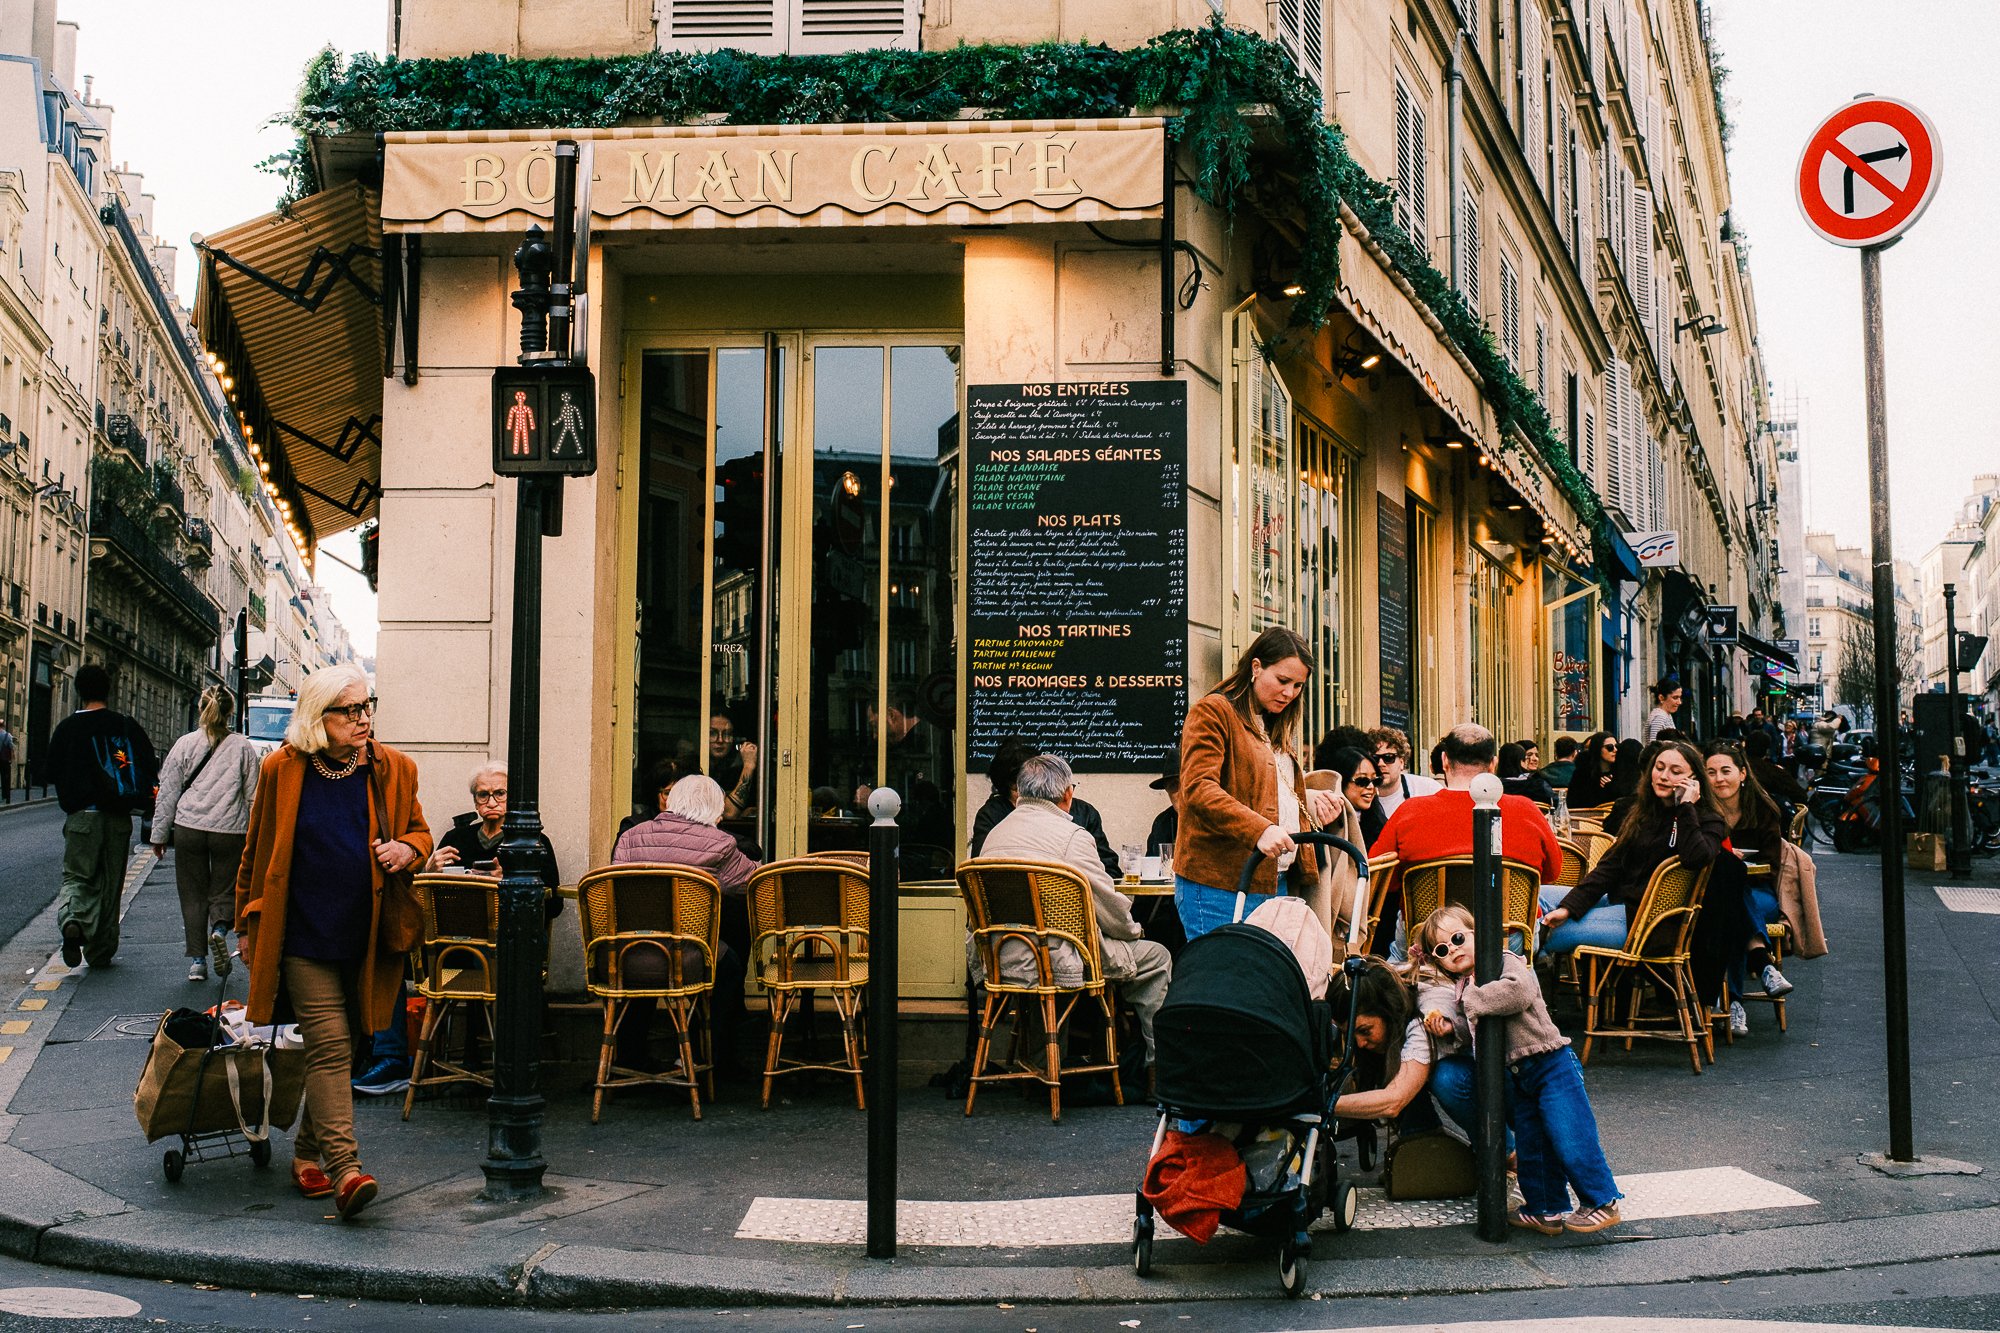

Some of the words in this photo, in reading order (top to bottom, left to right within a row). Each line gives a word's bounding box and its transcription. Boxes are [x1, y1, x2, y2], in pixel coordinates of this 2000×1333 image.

[850, 132, 1083, 202] CAFÉ
[1022, 384, 1051, 397] NOS
[1057, 381, 1130, 396] ENTRÉES
[973, 399, 995, 410] Soupe
[991, 450, 1021, 462] NOS
[1026, 449, 1091, 462] SALADES
[1095, 445, 1162, 461] GÉANTES
[975, 463, 1010, 472] SALADE
[1013, 463, 1059, 472] LANDAISE
[974, 474, 1005, 482] SALADE
[1008, 474, 1065, 482] NAPOLITAINE
[973, 483, 1003, 492] SALADE
[973, 492, 1004, 500] SALADE
[972, 502, 1002, 510] SALADE
[1038, 514, 1067, 527] NOS
[1072, 514, 1121, 526] PLATS
[1019, 626, 1051, 638] NOS
[1058, 624, 1131, 637] TARTINES
[974, 639, 1010, 648] TARTINE
[1013, 639, 1065, 648] SAVOYARDE
[712, 644, 742, 654] TIREZ
[973, 650, 1009, 658] TARTINE
[1012, 650, 1056, 658] ITALIENNE
[972, 662, 1006, 670] TARTINE
[1022, 662, 1052, 670] SEGUIN
[974, 676, 1002, 688] NOS
[1008, 676, 1087, 688] FROMAGES
[1095, 676, 1104, 688] &
[1108, 675, 1183, 688] DESSERTS
